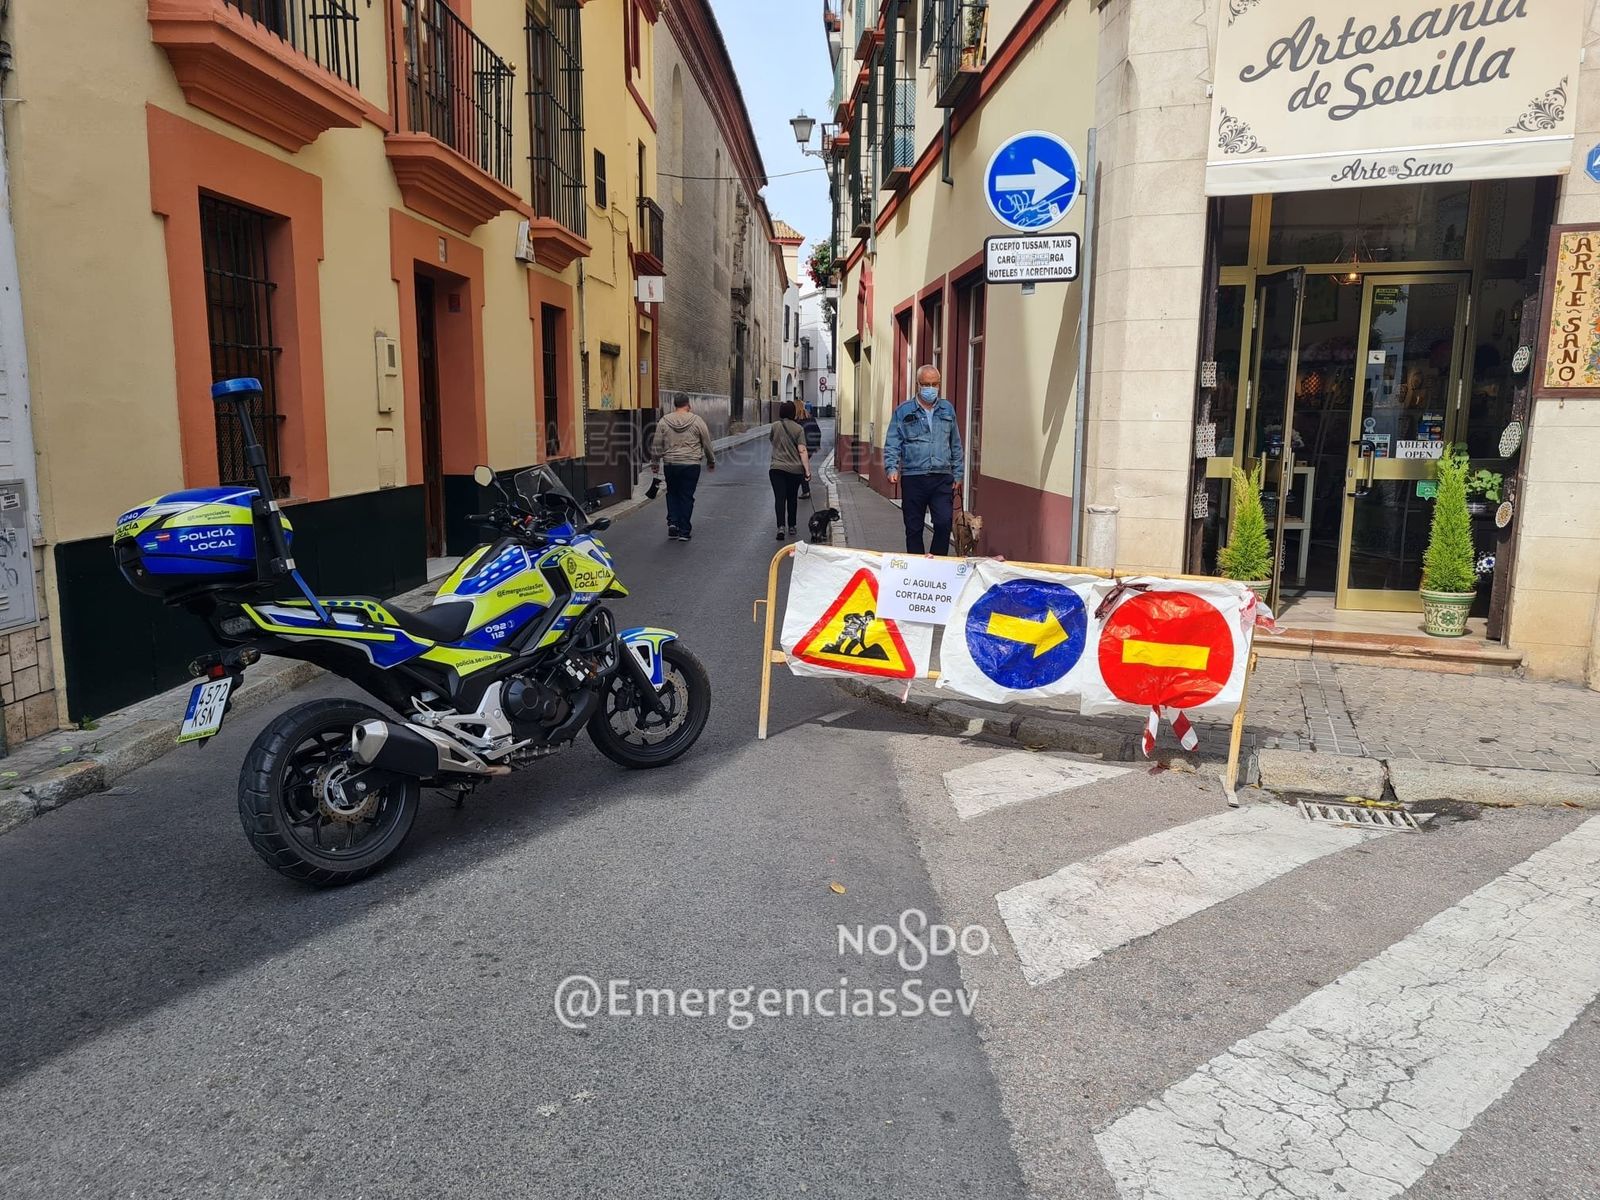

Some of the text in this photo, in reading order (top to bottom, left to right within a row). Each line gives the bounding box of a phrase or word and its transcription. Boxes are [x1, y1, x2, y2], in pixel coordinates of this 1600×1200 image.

[1288, 36, 1516, 121] de Sevilla
[1331, 157, 1453, 182] Arte Sano
[990, 239, 1072, 251] EXCEPTO TUSSAM, TAXIS
[989, 268, 1018, 278] HOTELES
[1019, 268, 1024, 277] Y
[1397, 440, 1443, 449] ABIERTO
[1405, 450, 1433, 458] OPEN
[179, 527, 236, 543] POLICÍA
[190, 539, 237, 552] LOCAL
[575, 568, 611, 582] POLICÍA
[574, 580, 599, 589] LOCAL
[912, 579, 947, 590] AGUILAS
[895, 590, 952, 603] CORTADA POR
[908, 603, 937, 614] OBRAS
[485, 622, 507, 634] 092
[490, 630, 505, 640] 112
[198, 682, 229, 707] 4572
[191, 705, 216, 729] KSN
